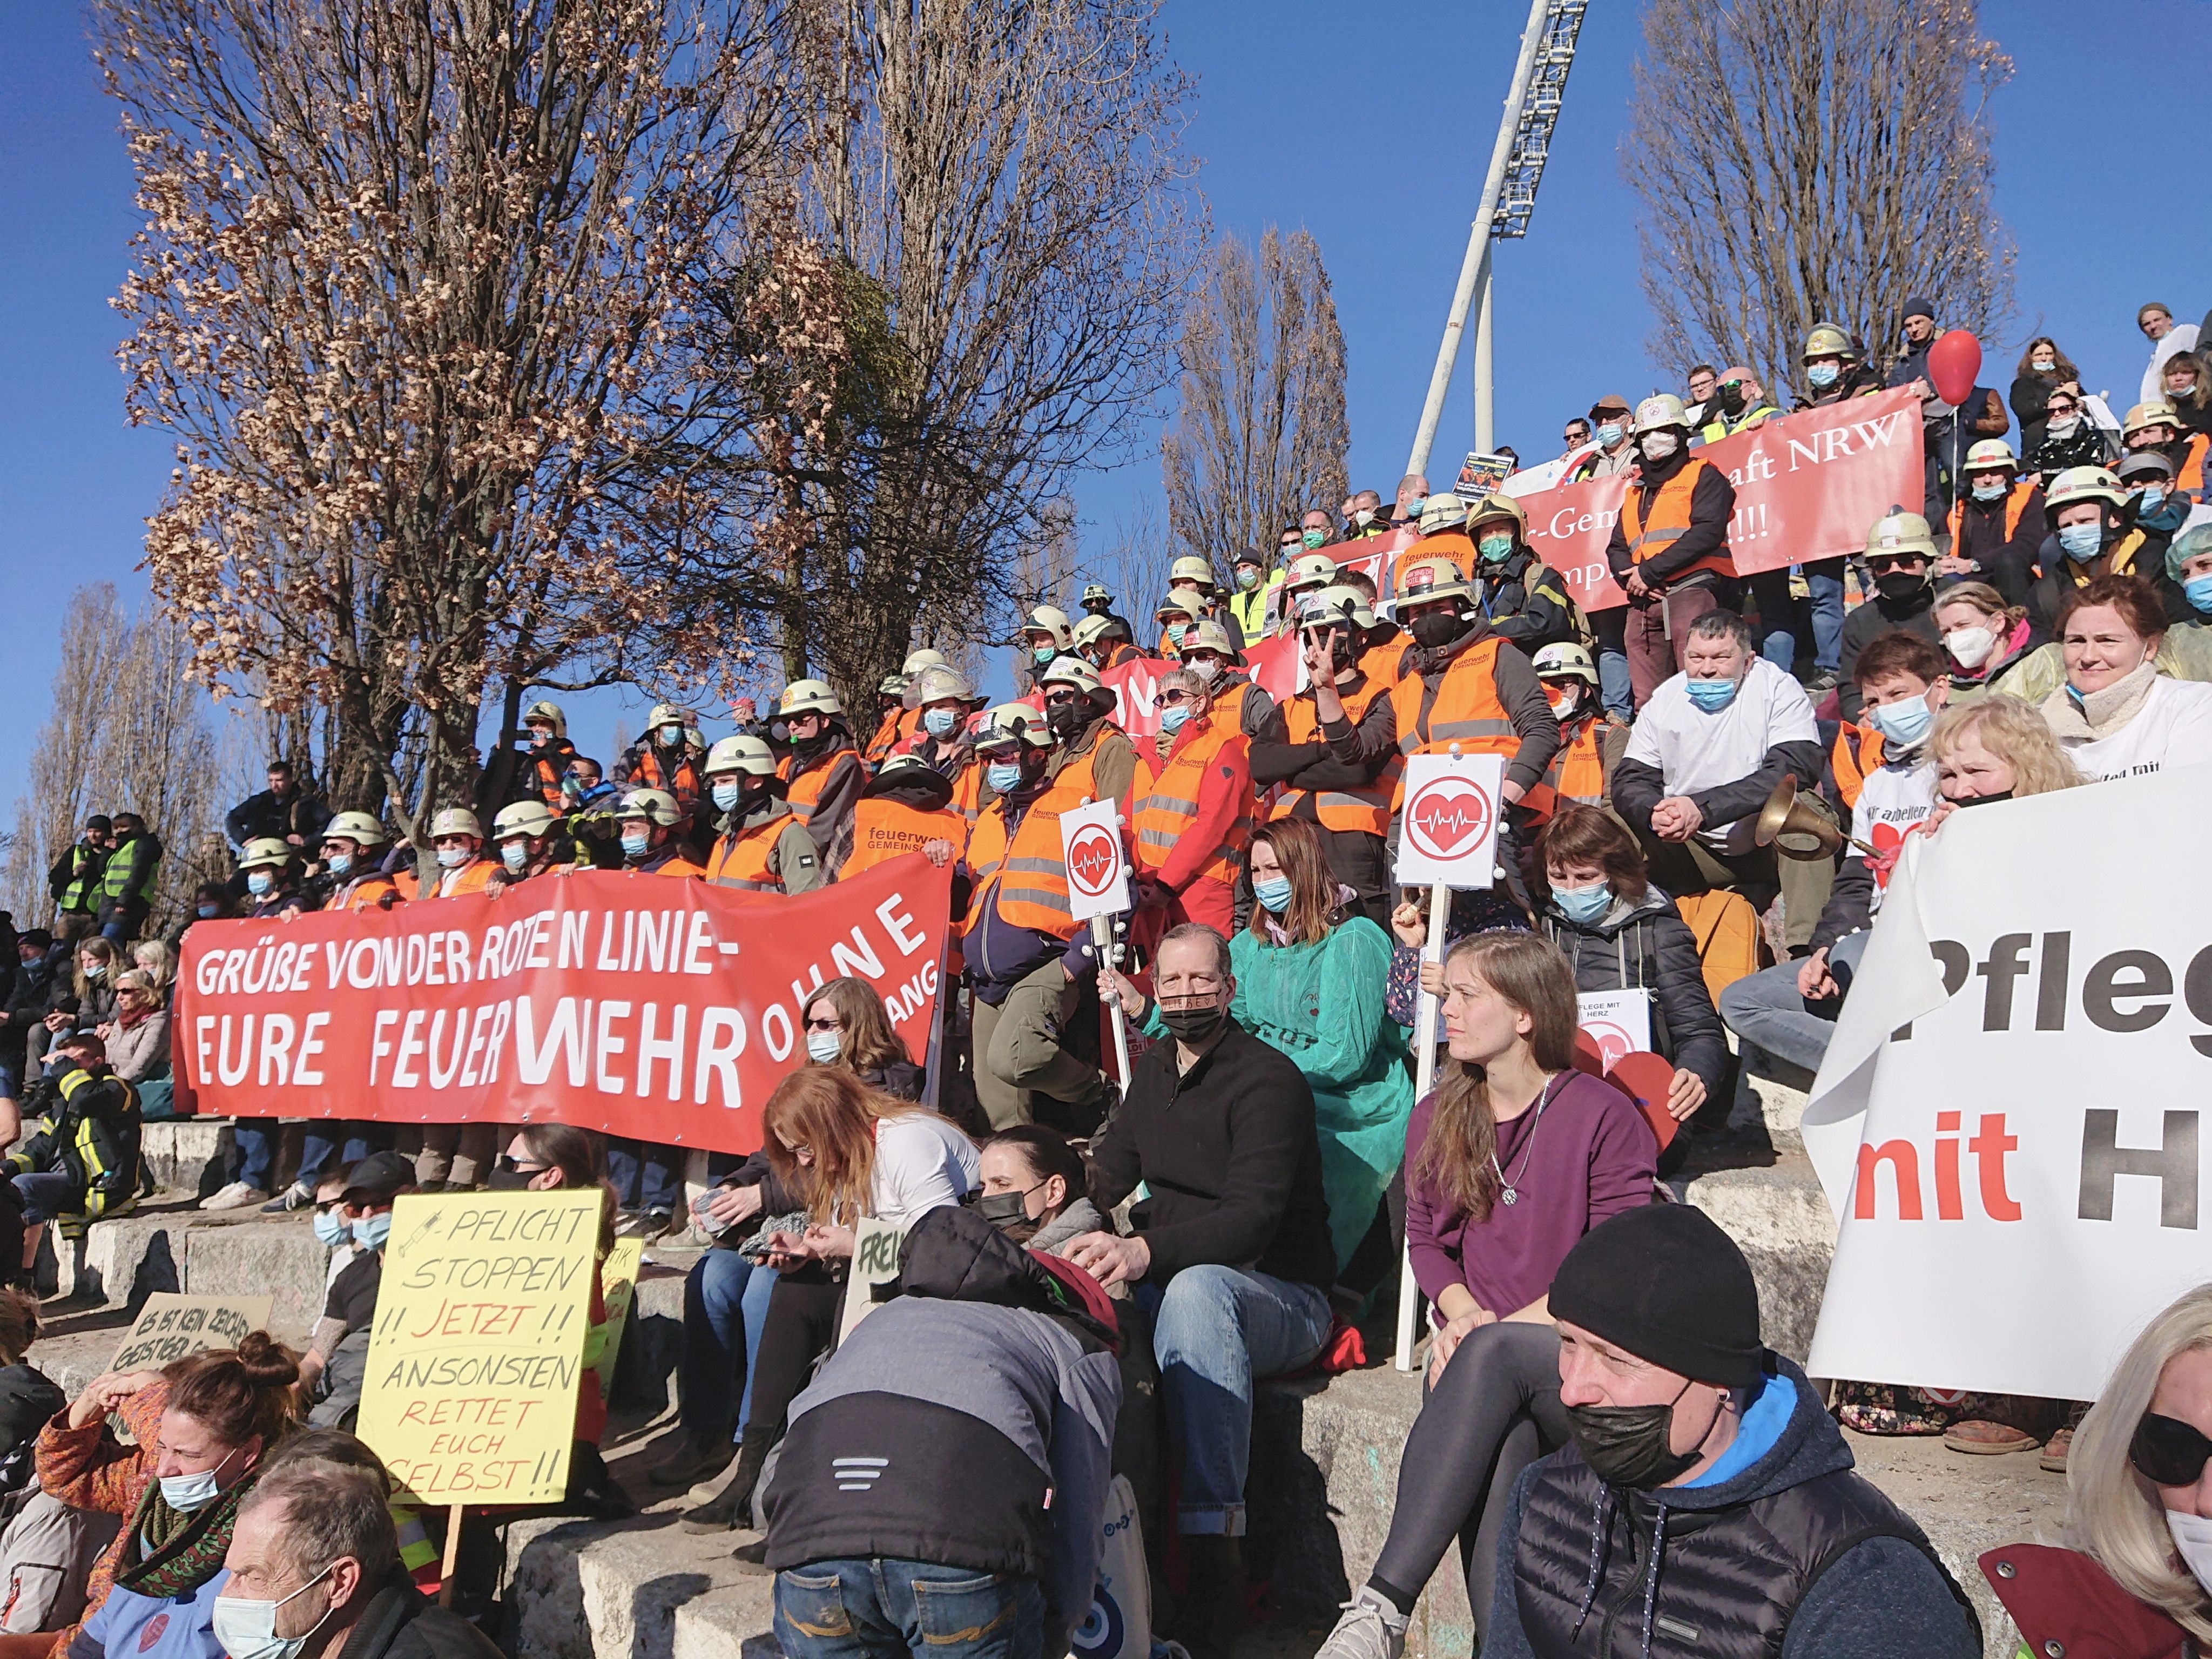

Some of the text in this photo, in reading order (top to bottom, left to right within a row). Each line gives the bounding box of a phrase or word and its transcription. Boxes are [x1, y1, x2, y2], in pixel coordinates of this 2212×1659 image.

[1786, 410, 1904, 473] NRW
[1405, 550, 1465, 562] feuerwehr
[1881, 805, 1927, 821] arbeiten
[869, 827, 943, 844] feuerw
[197, 934, 319, 995] GRÜßE
[195, 1011, 331, 1088] EURE
[858, 1229, 905, 1274] FREI
[400, 1255, 586, 1292] STOPPEN
[157, 1309, 181, 1332] IST
[177, 1308, 209, 1332] KEIN
[410, 1298, 537, 1338] JETZT
[381, 1353, 579, 1391] ANSONSTEN
[397, 1398, 543, 1430] RETTET
[429, 1434, 506, 1455] EUCH
